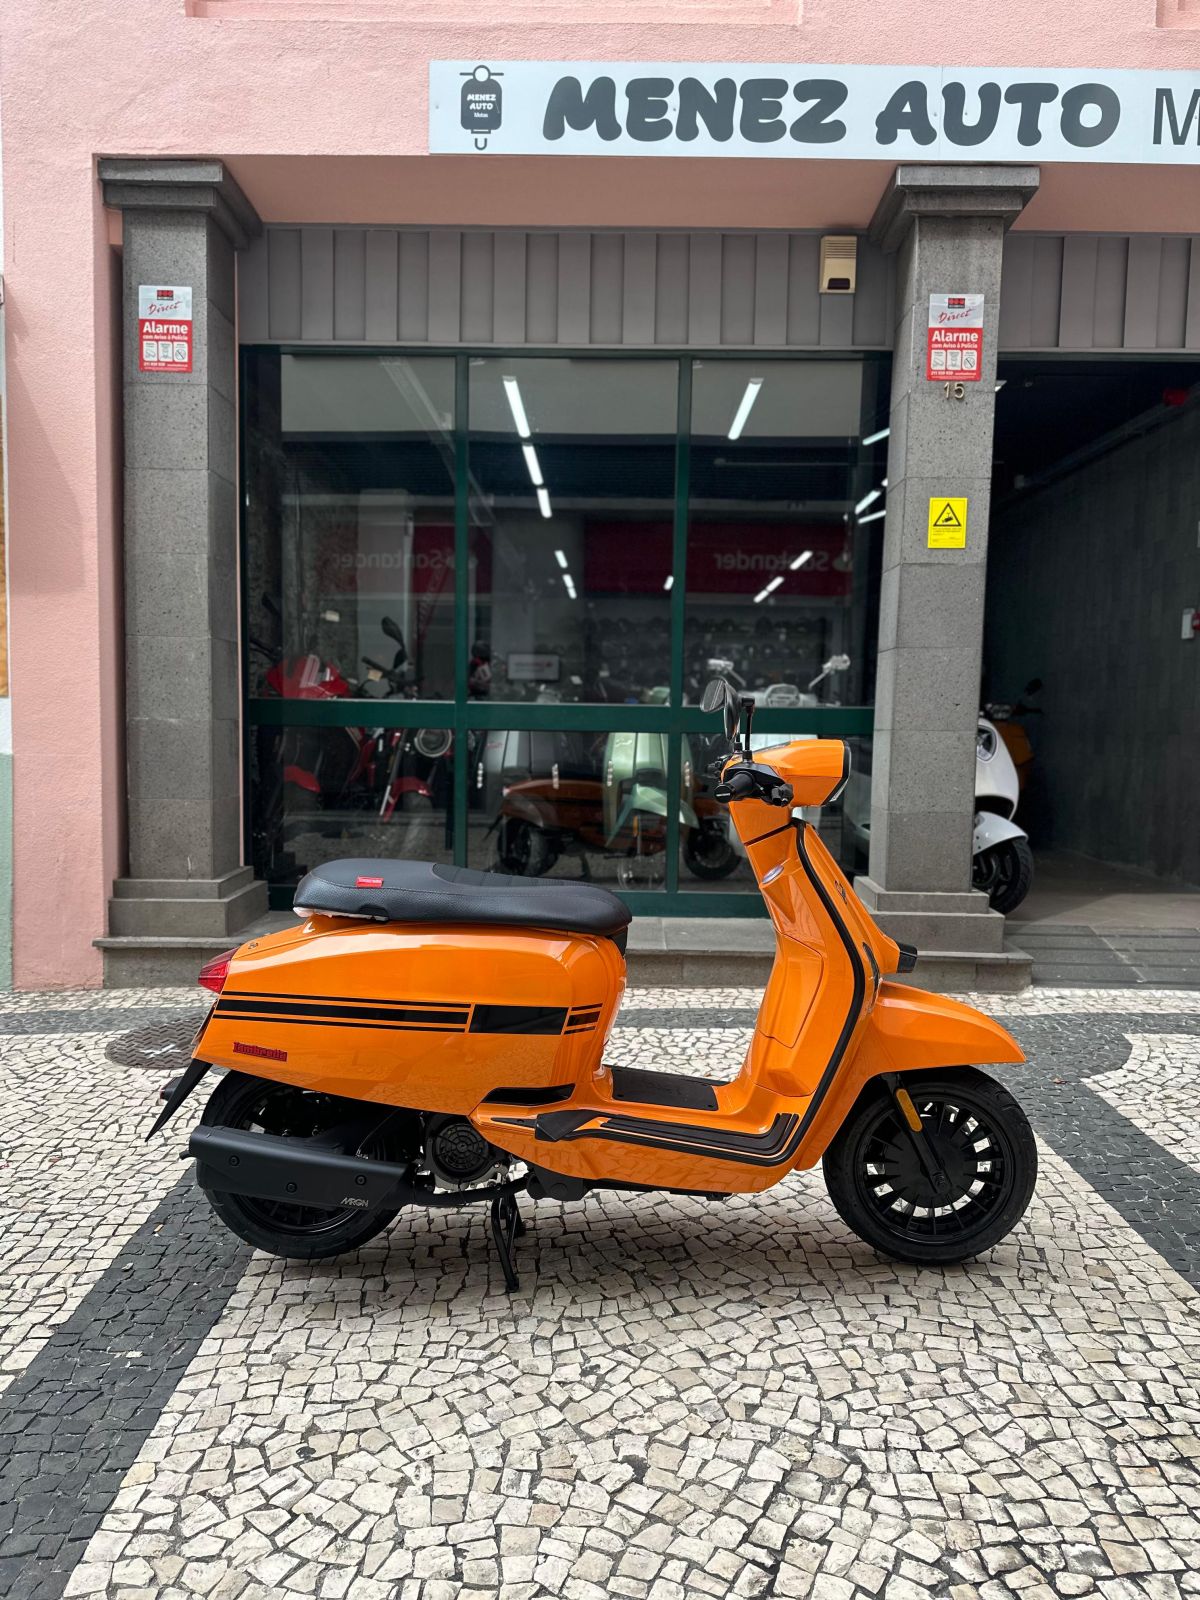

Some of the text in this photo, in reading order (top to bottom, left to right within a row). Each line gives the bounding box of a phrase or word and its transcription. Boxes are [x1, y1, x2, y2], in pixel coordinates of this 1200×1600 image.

[543, 76, 848, 143] MENEZ
[876, 81, 1120, 147] AUTO
[148, 301, 182, 315] Direct
[939, 308, 975, 323] Direct
[143, 321, 188, 334] Alarme
[932, 330, 978, 342] Alarme
[944, 381, 965, 399] 15
